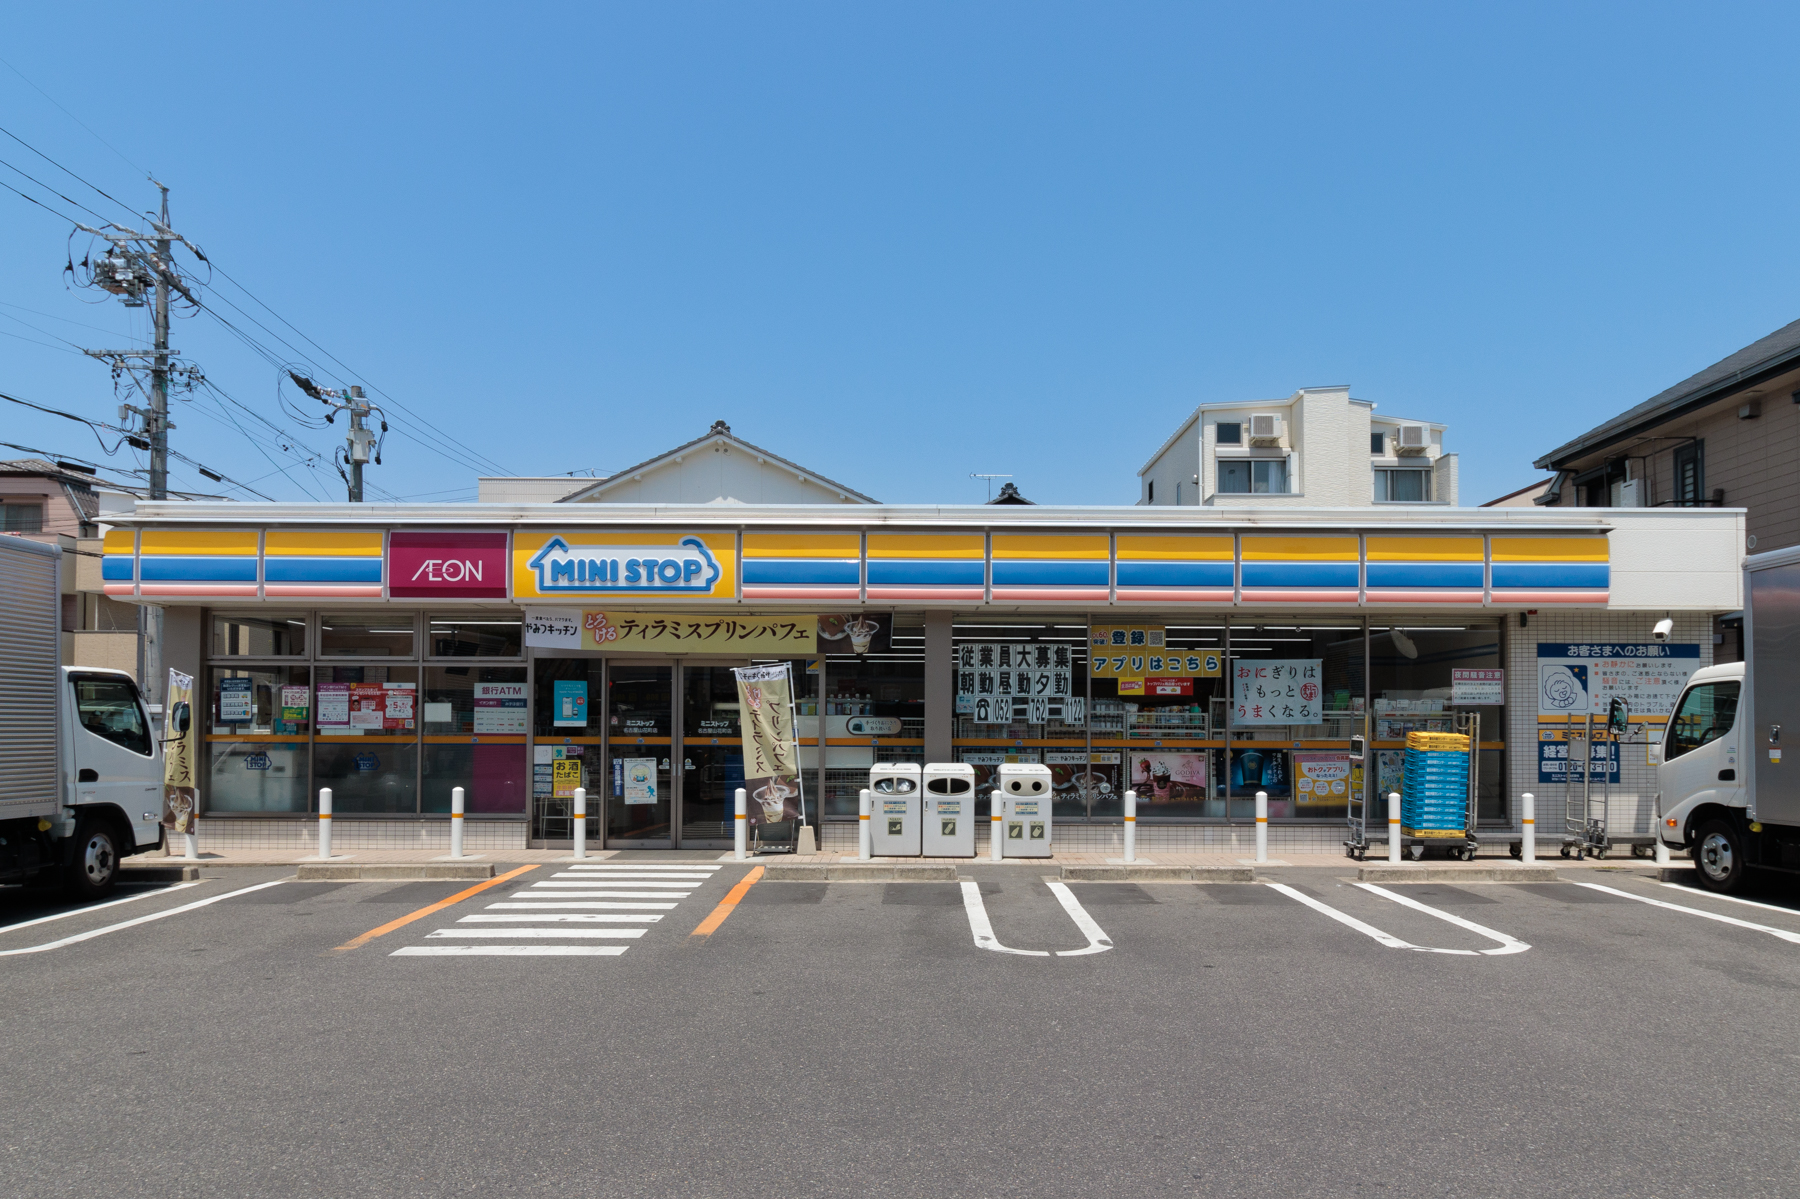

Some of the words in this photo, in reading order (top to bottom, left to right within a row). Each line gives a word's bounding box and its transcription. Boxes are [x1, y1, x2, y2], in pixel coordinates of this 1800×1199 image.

[551, 558, 619, 583] MINI
[625, 558, 702, 583] STOP
[526, 623, 578, 636] やみつキッチン
[620, 619, 810, 641] ティラミスプリンパフェ
[1111, 630, 1146, 646] 登録
[960, 645, 1069, 668] 従業員大募集
[1567, 645, 1670, 657] お客さまへのお願い
[1092, 656, 1219, 672] アプリはこちら
[1236, 665, 1316, 680] おにぎりは
[960, 671, 1068, 695] 朝勤昼勤夕勤
[481, 686, 522, 696] 銀行ATM
[1256, 684, 1296, 699] もっと
[1238, 704, 1319, 718] うまくなる。
[555, 761, 579, 771] お酒
[555, 771, 579, 779] たばこ
[1060, 792, 1119, 800] ティラミスリンパフェ
